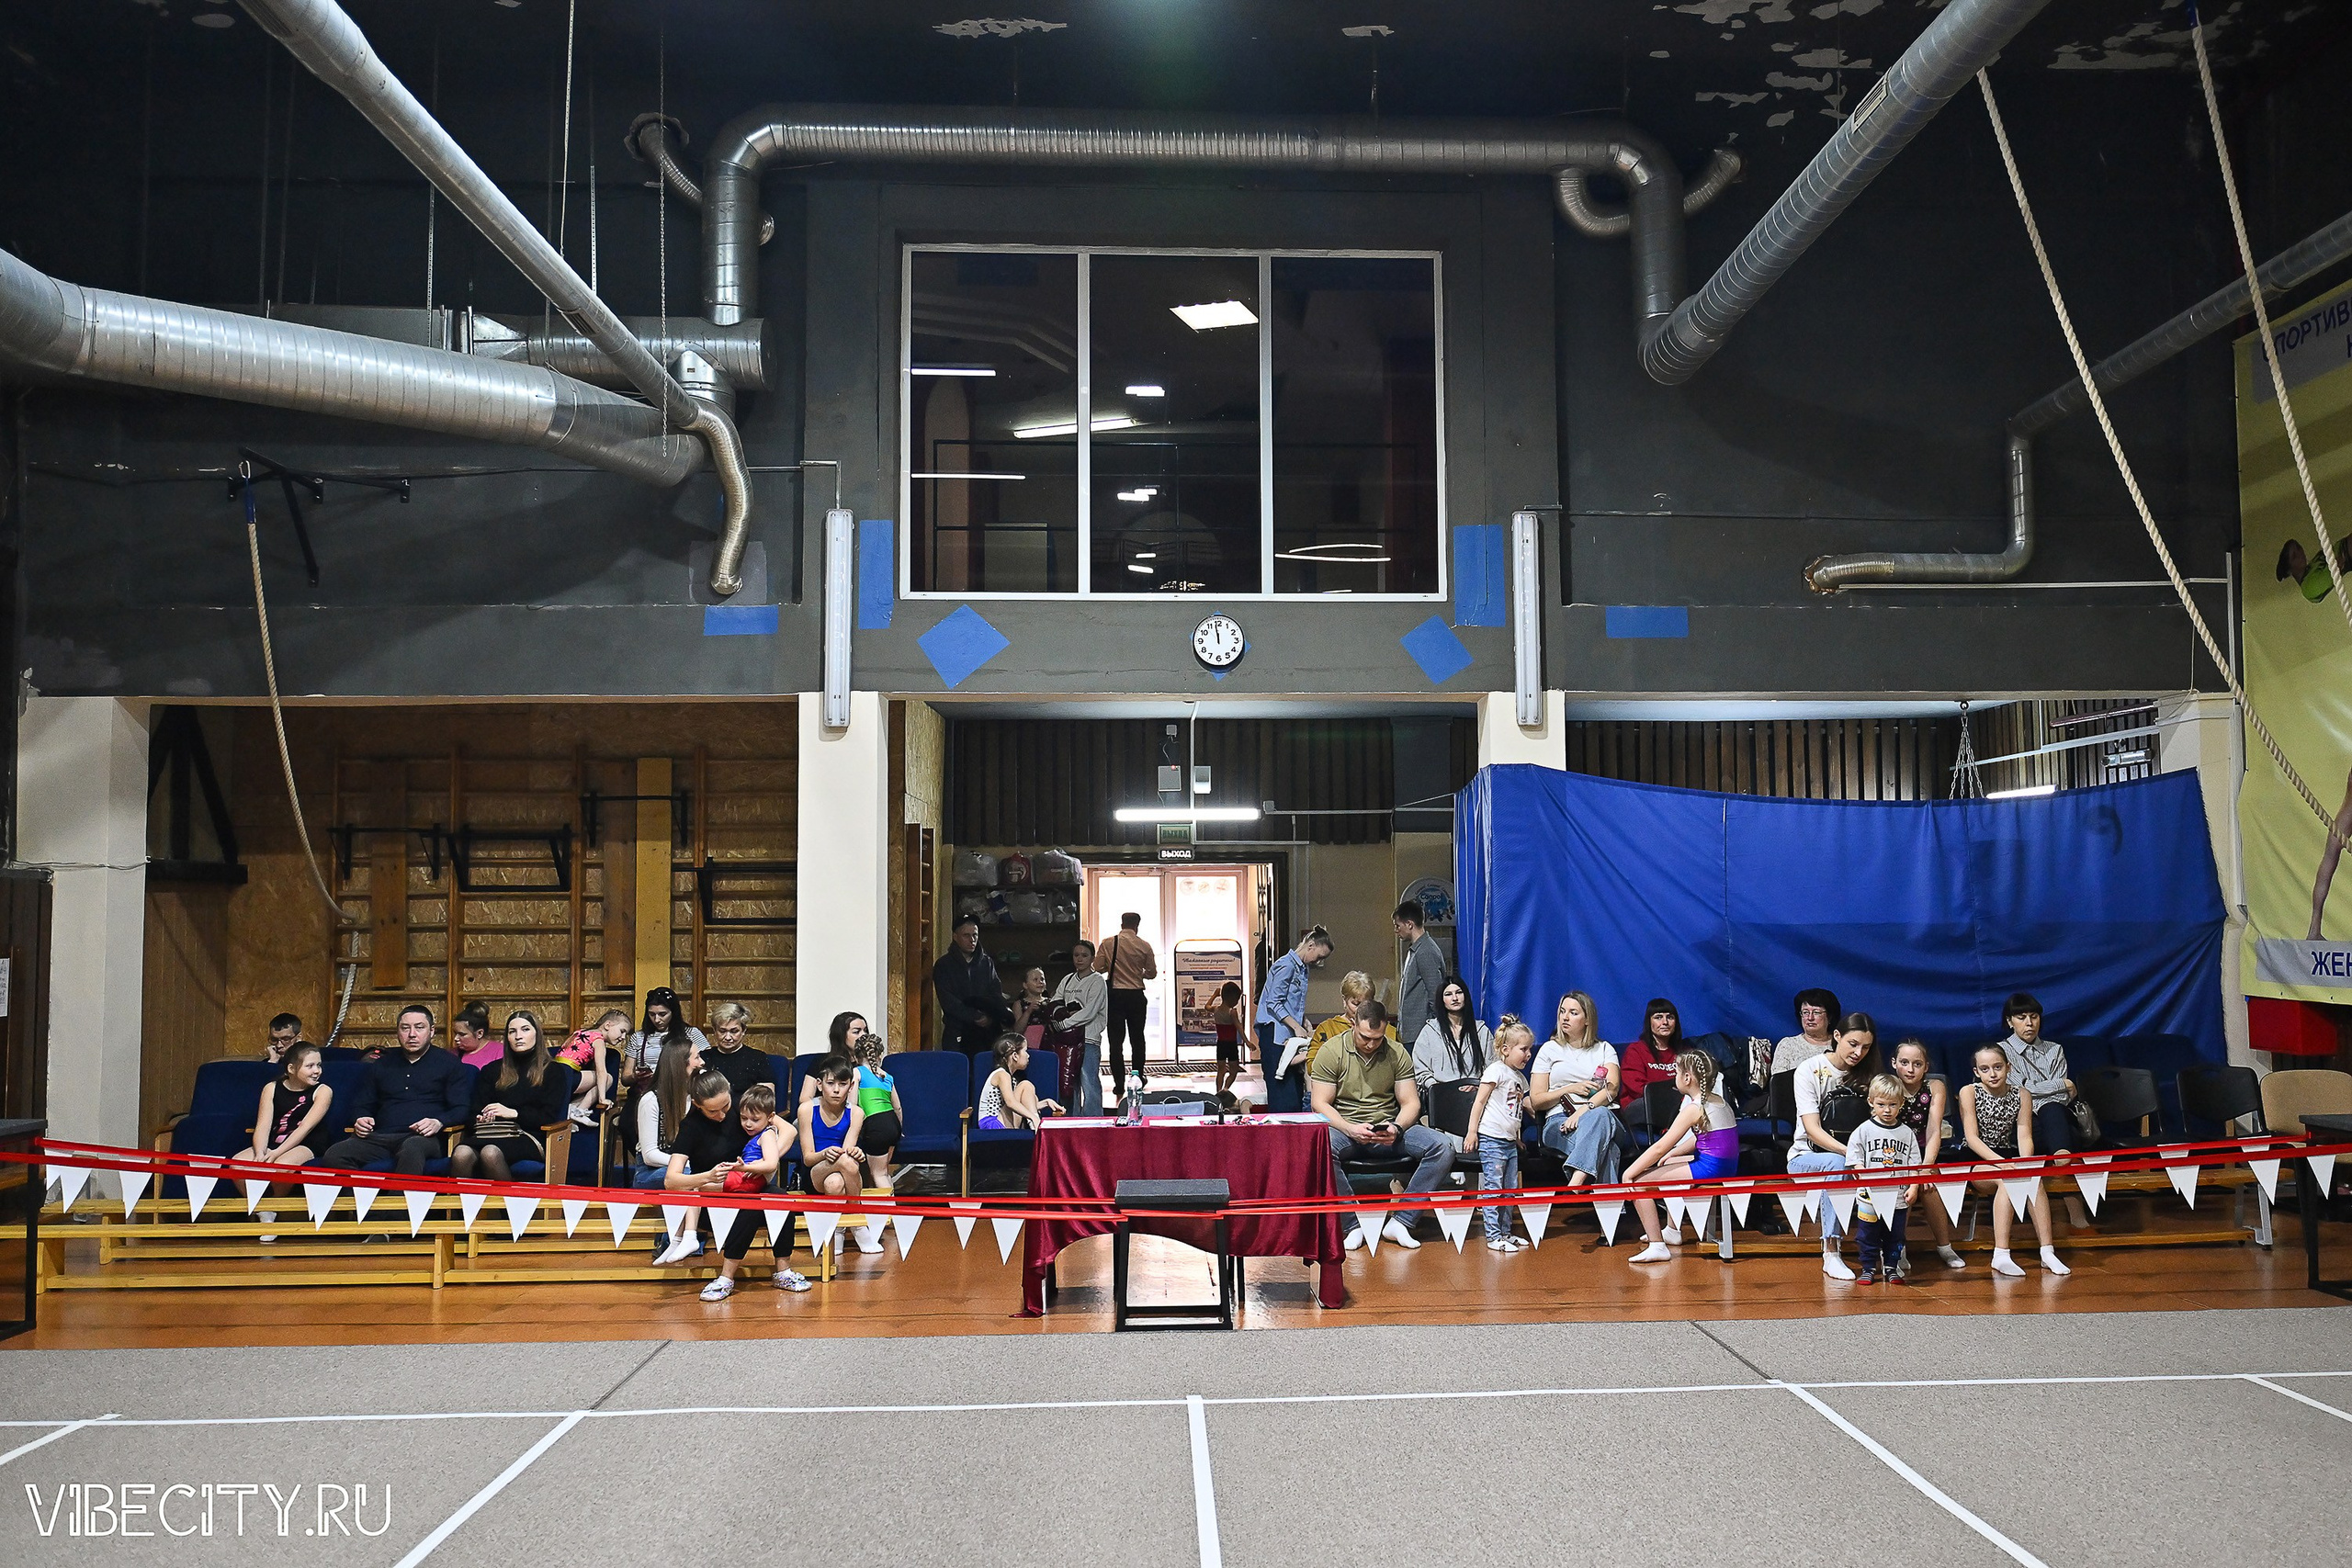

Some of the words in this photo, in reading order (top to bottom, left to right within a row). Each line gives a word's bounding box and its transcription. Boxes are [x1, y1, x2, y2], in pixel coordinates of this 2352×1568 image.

[2262, 297, 2352, 363] ПОРТИВ
[1161, 850, 1192, 858] ВЫХОД
[1868, 1138, 1909, 1156] LEAGUE
